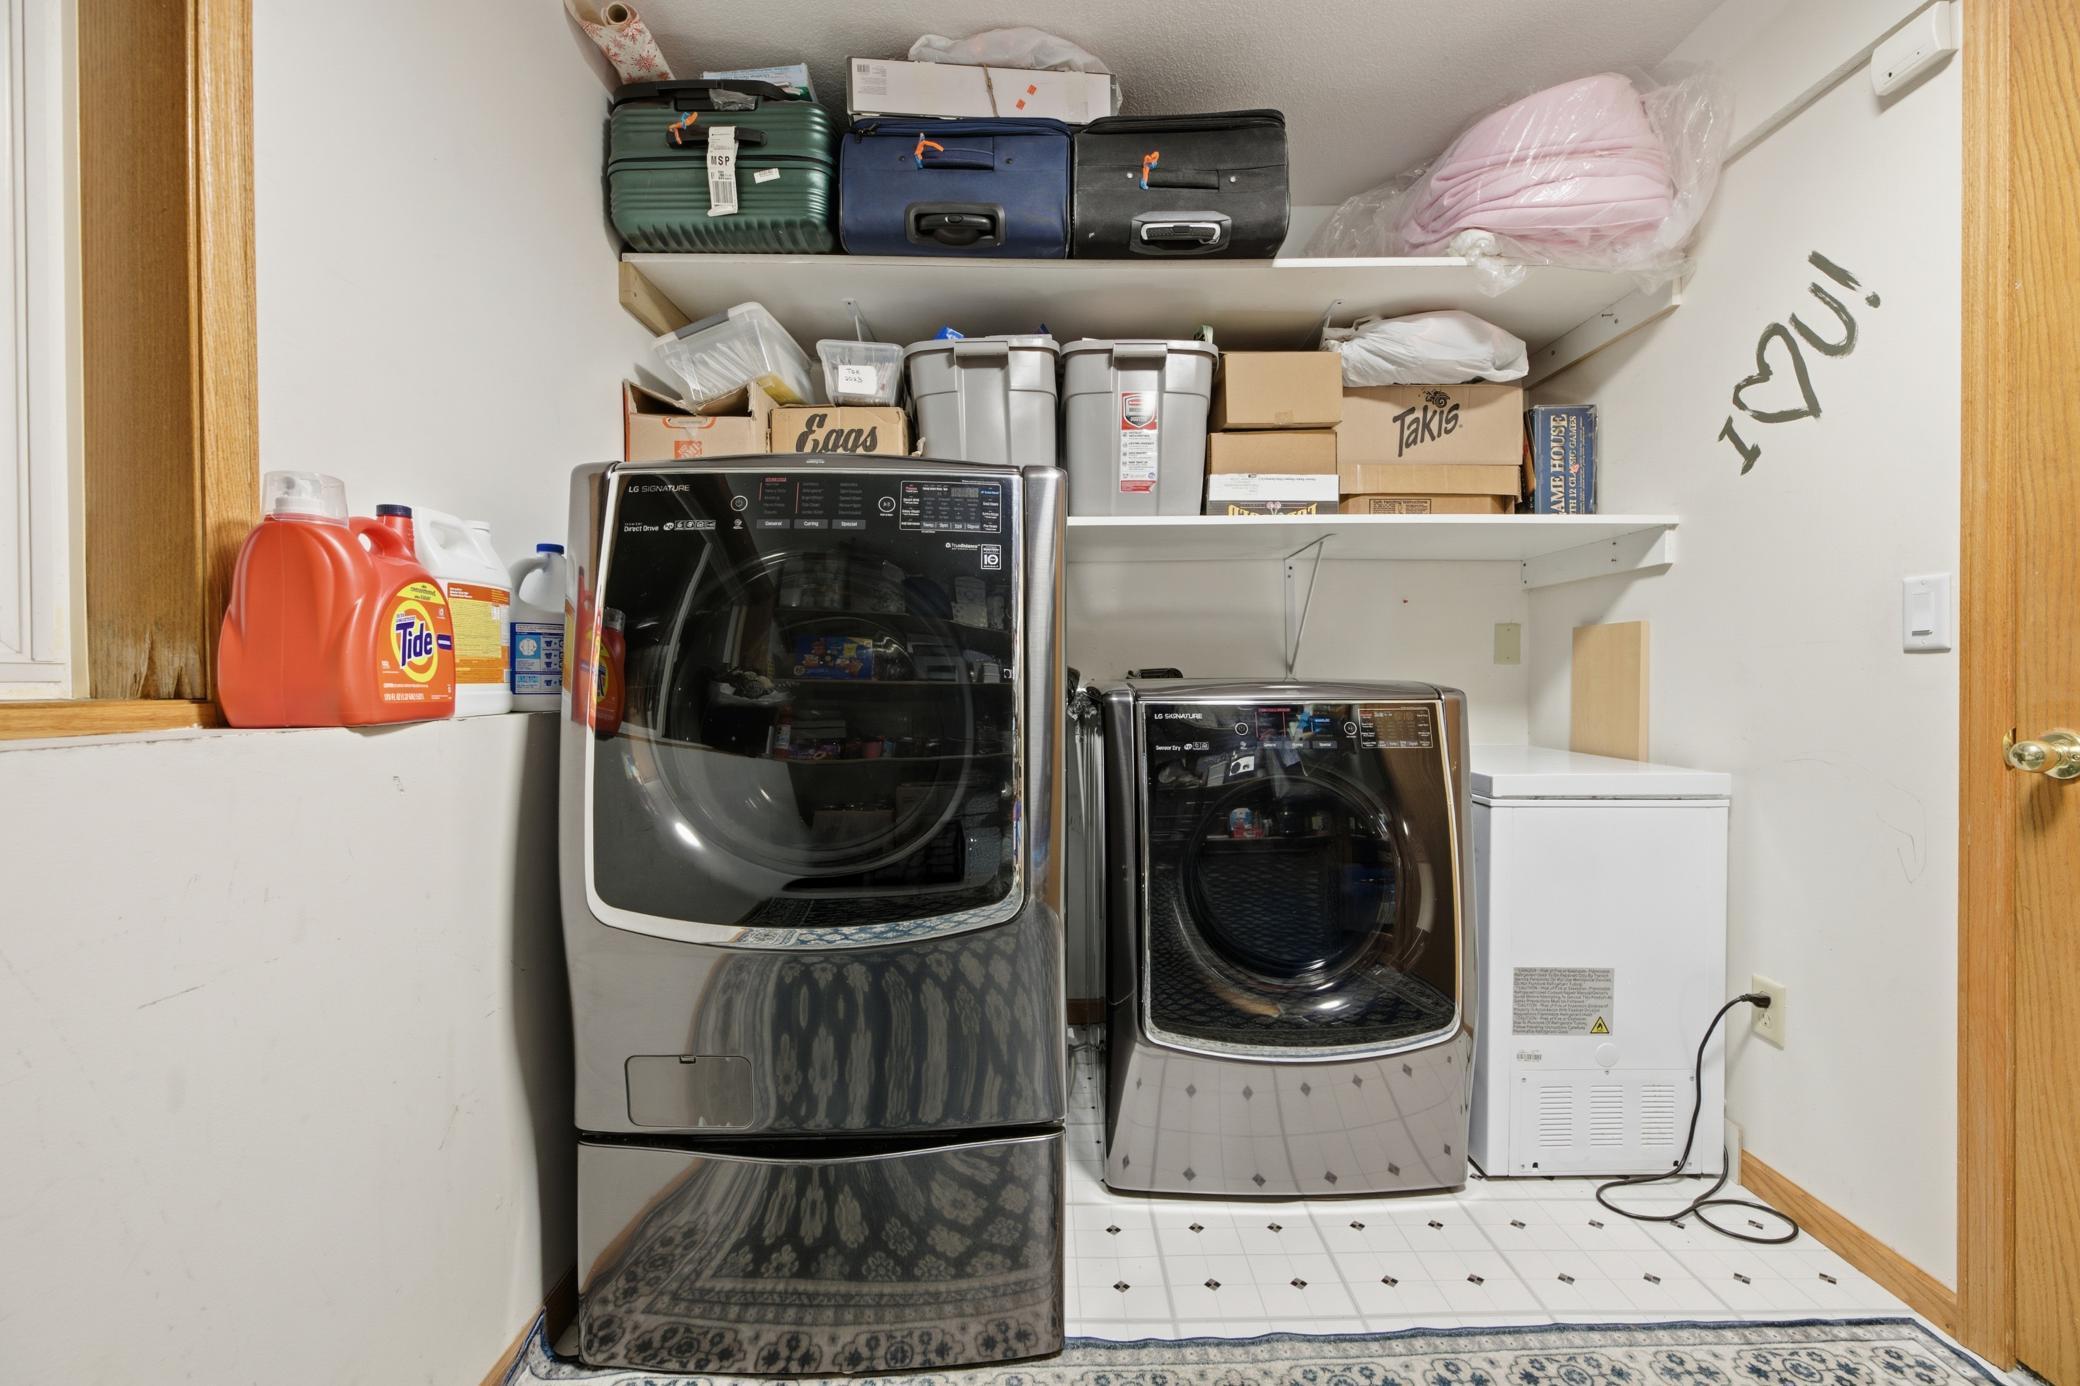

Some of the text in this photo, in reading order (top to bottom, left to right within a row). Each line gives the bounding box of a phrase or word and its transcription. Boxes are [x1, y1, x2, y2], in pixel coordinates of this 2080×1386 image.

[711, 155, 730, 166] MSP
[1392, 403, 1460, 458] Takis
[1569, 415, 1577, 449] GAMES
[1717, 415, 1762, 476] I
[1550, 414, 1568, 514] AME HOUSE
[628, 484, 690, 493] LG SIGNATURE
[395, 621, 433, 668] Tide
